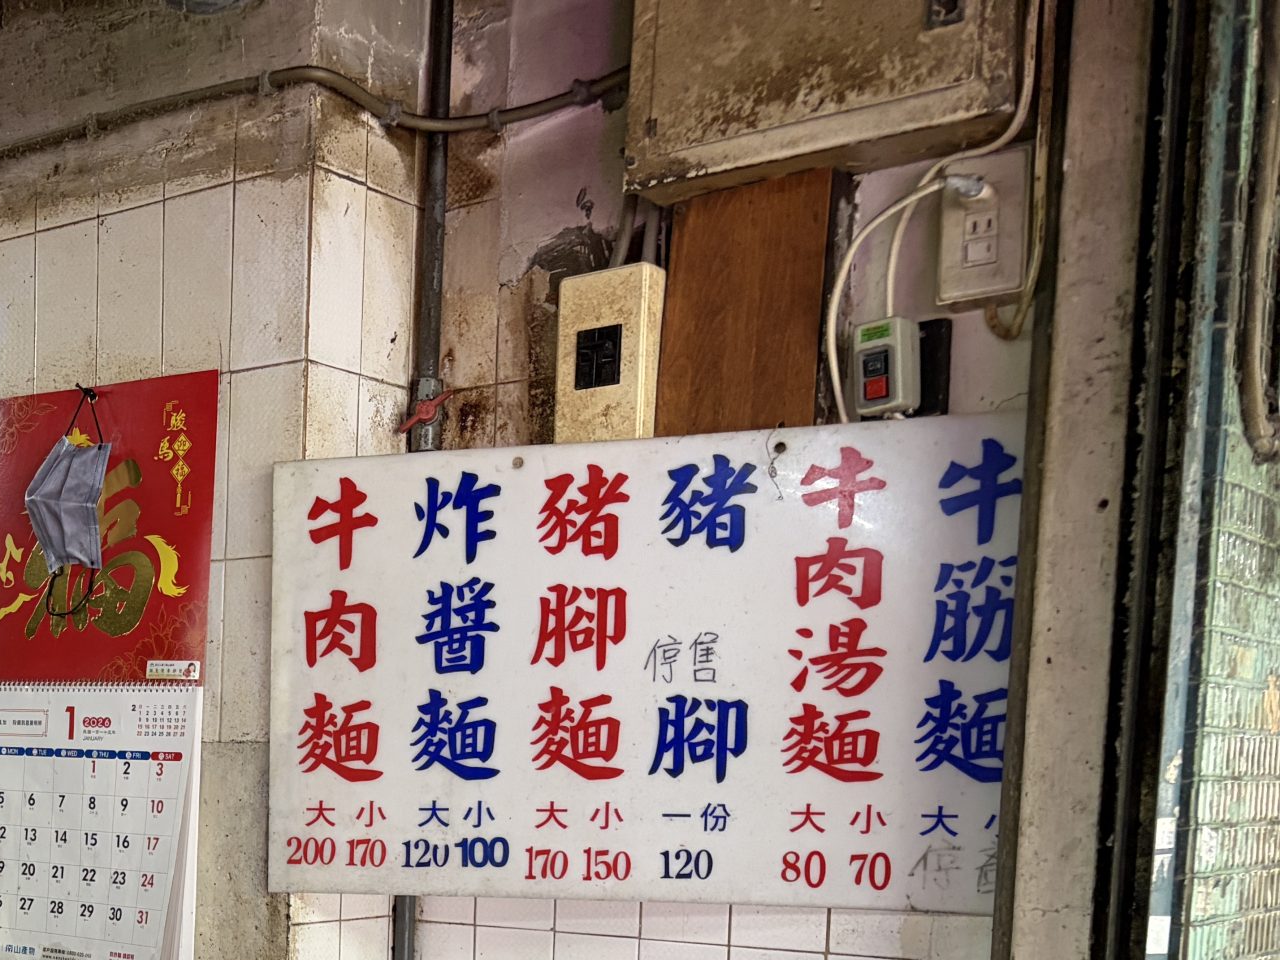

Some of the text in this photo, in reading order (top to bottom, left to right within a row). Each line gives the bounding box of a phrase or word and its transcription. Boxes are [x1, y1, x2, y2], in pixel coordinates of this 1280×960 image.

[410, 471, 501, 781] 炸醬麵
[530, 464, 630, 780] 豬腳麵
[781, 447, 887, 782] 牛肉湯麵
[915, 439, 1022, 787] 牛筋麵
[297, 477, 383, 782] 牛肉麵
[65, 706, 75, 740] 1
[83, 717, 111, 728] 2026
[91, 759, 164, 777] 1 2 3
[27, 792, 36, 807] 6
[58, 794, 66, 808] 7
[88, 796, 96, 811] 8
[120, 797, 129, 812] 9
[150, 799, 164, 814] 10
[305, 800, 386, 827] 大 小
[418, 800, 495, 828] 大 小
[535, 801, 623, 830] 大 小
[662, 803, 731, 832] 一份
[790, 804, 887, 833] 大 小
[920, 806, 958, 837] 大
[23, 827, 37, 842] 13
[54, 829, 68, 844] 14
[83, 832, 98, 847] 15
[115, 834, 130, 849] 16
[146, 836, 160, 851] 17
[287, 837, 386, 867] 200 170
[402, 837, 509, 868] 120 100
[21, 862, 36, 877] 20
[51, 864, 65, 880] 21
[81, 867, 97, 883] 22
[111, 870, 127, 886] 23
[140, 873, 155, 888] 24
[525, 847, 631, 881] 170 150
[660, 849, 713, 879] 120
[781, 851, 891, 890] 80 70
[19, 896, 35, 911] 27
[49, 900, 64, 915] 28
[79, 903, 95, 918] 29
[108, 906, 123, 922] 30
[136, 910, 149, 925] 31
